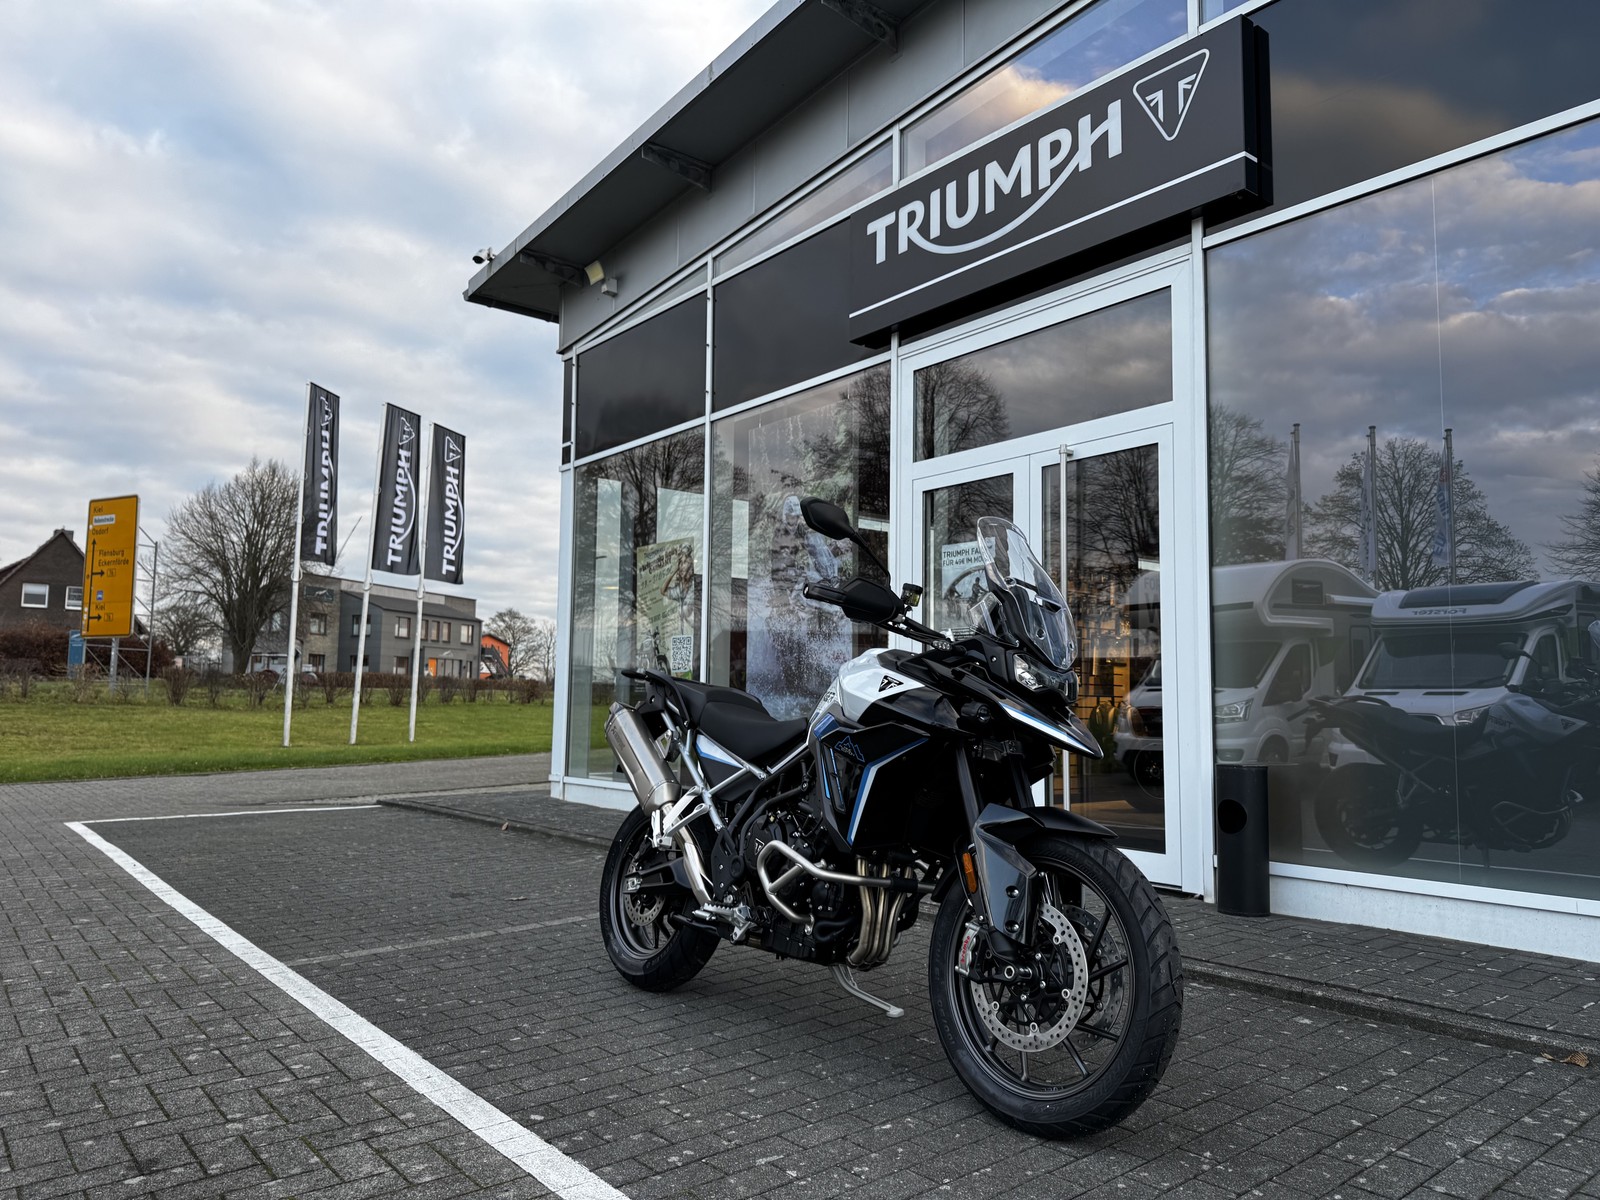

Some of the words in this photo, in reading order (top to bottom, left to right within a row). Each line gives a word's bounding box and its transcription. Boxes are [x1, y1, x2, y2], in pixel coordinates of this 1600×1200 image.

[866, 99, 1123, 265] TRIUMPH
[386, 449, 416, 566] TRIUMPH
[441, 466, 464, 576] TRIUMPH
[98, 549, 125, 558] Flensburg
[943, 549, 970, 558] TRIUMPH
[971, 547, 981, 555] FA
[98, 558, 129, 567] Eckernförde
[942, 558, 954, 567] FÜR
[95, 603, 106, 611] Kiel
[960, 935, 971, 963] brembo
